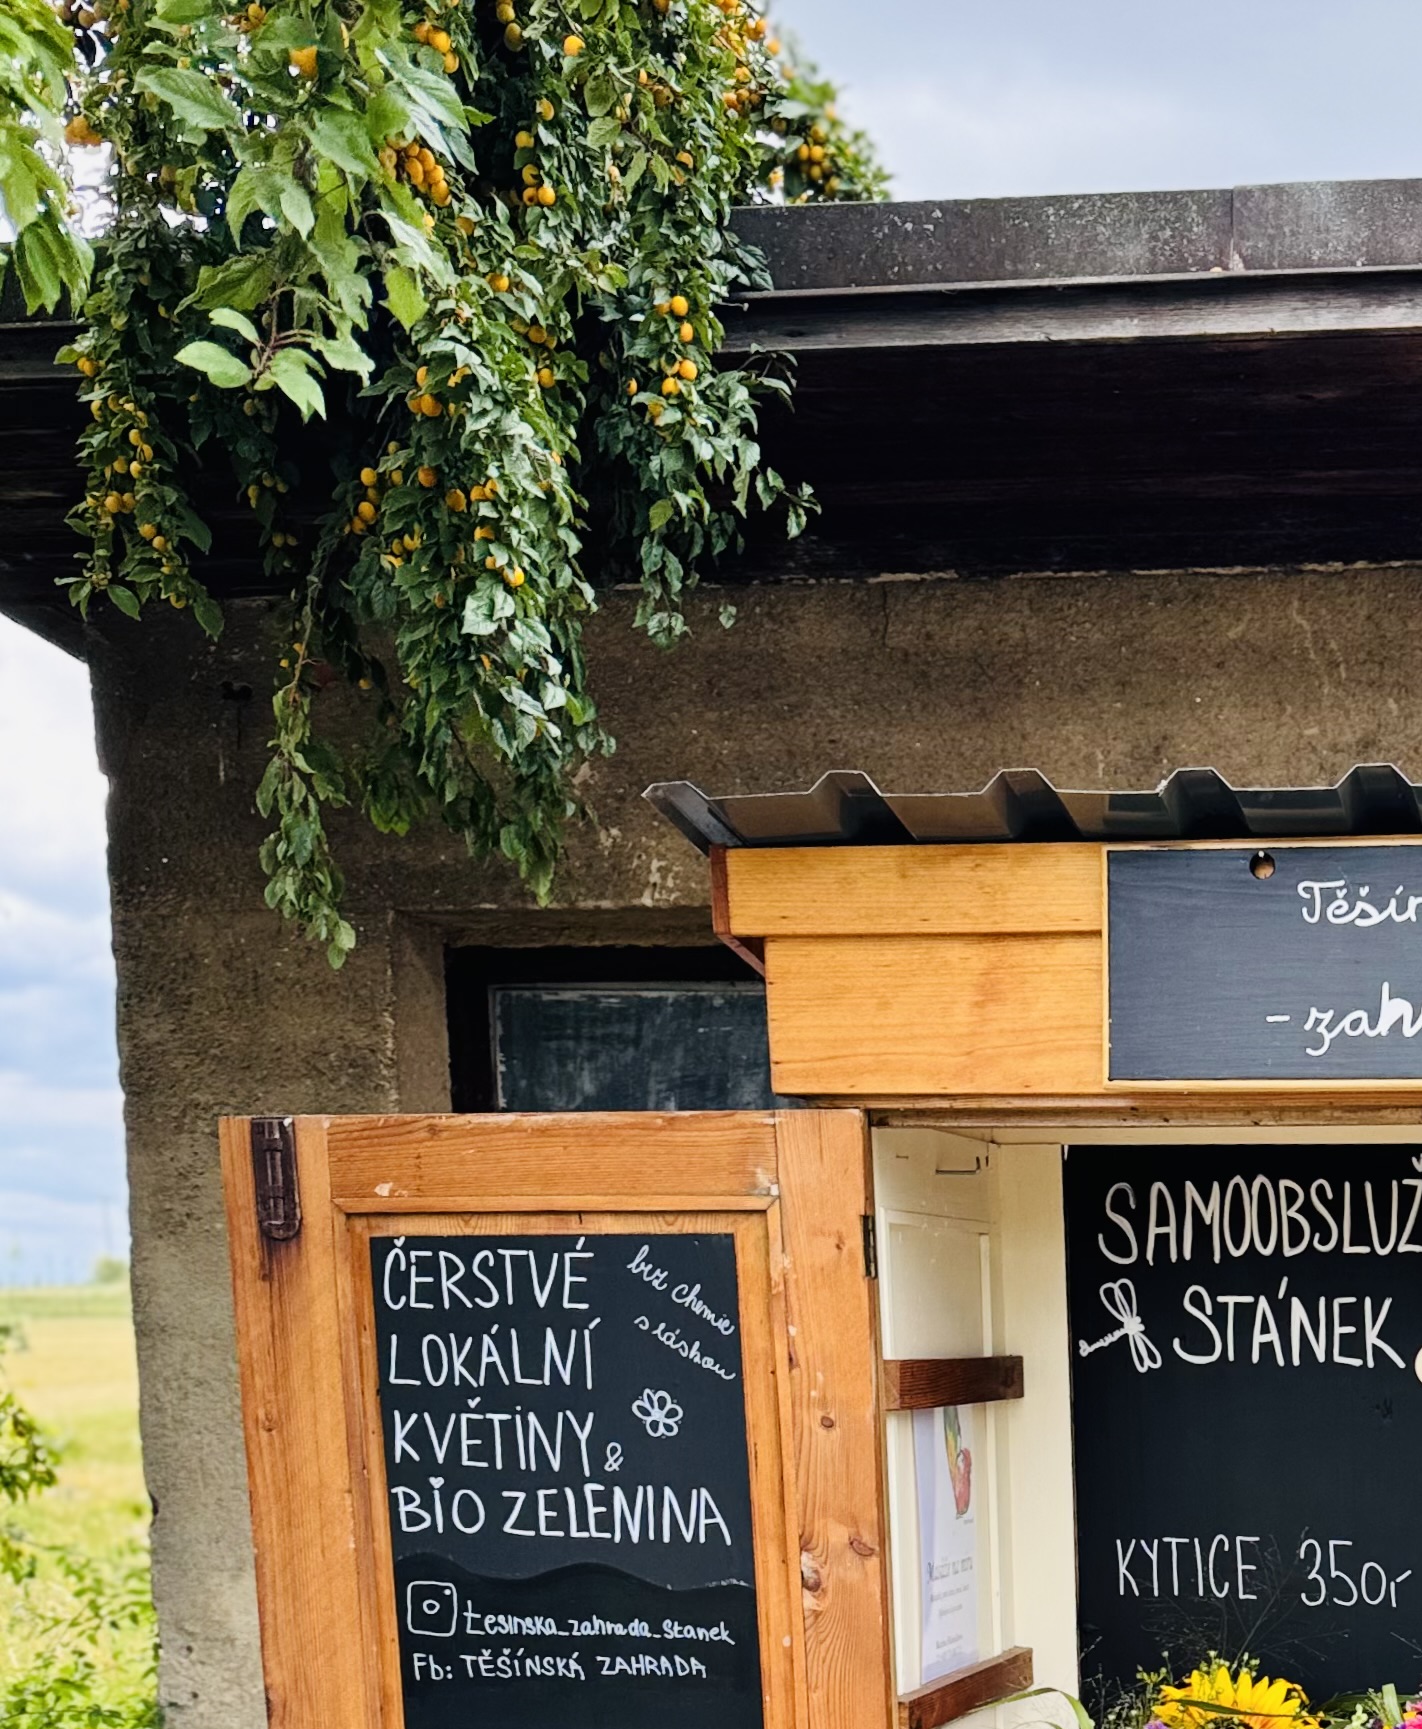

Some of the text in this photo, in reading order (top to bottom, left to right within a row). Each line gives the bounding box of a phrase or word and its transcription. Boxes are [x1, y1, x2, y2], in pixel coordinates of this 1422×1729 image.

[384, 1236, 594, 1310] ČERSTVÉ
[627, 1245, 734, 1335] bez chemie
[389, 1318, 601, 1389] LOKÁLNÍ
[634, 1316, 737, 1380] s láskou
[1173, 1277, 1406, 1368] STÁNEK
[394, 1397, 623, 1477] KVĚTINY &
[502, 1483, 731, 1545] ZELENINA
[1116, 1534, 1260, 1599] KYTICE
[413, 1648, 706, 1680] Fb: TĚŠÍNSKÁ ZAHRADA
